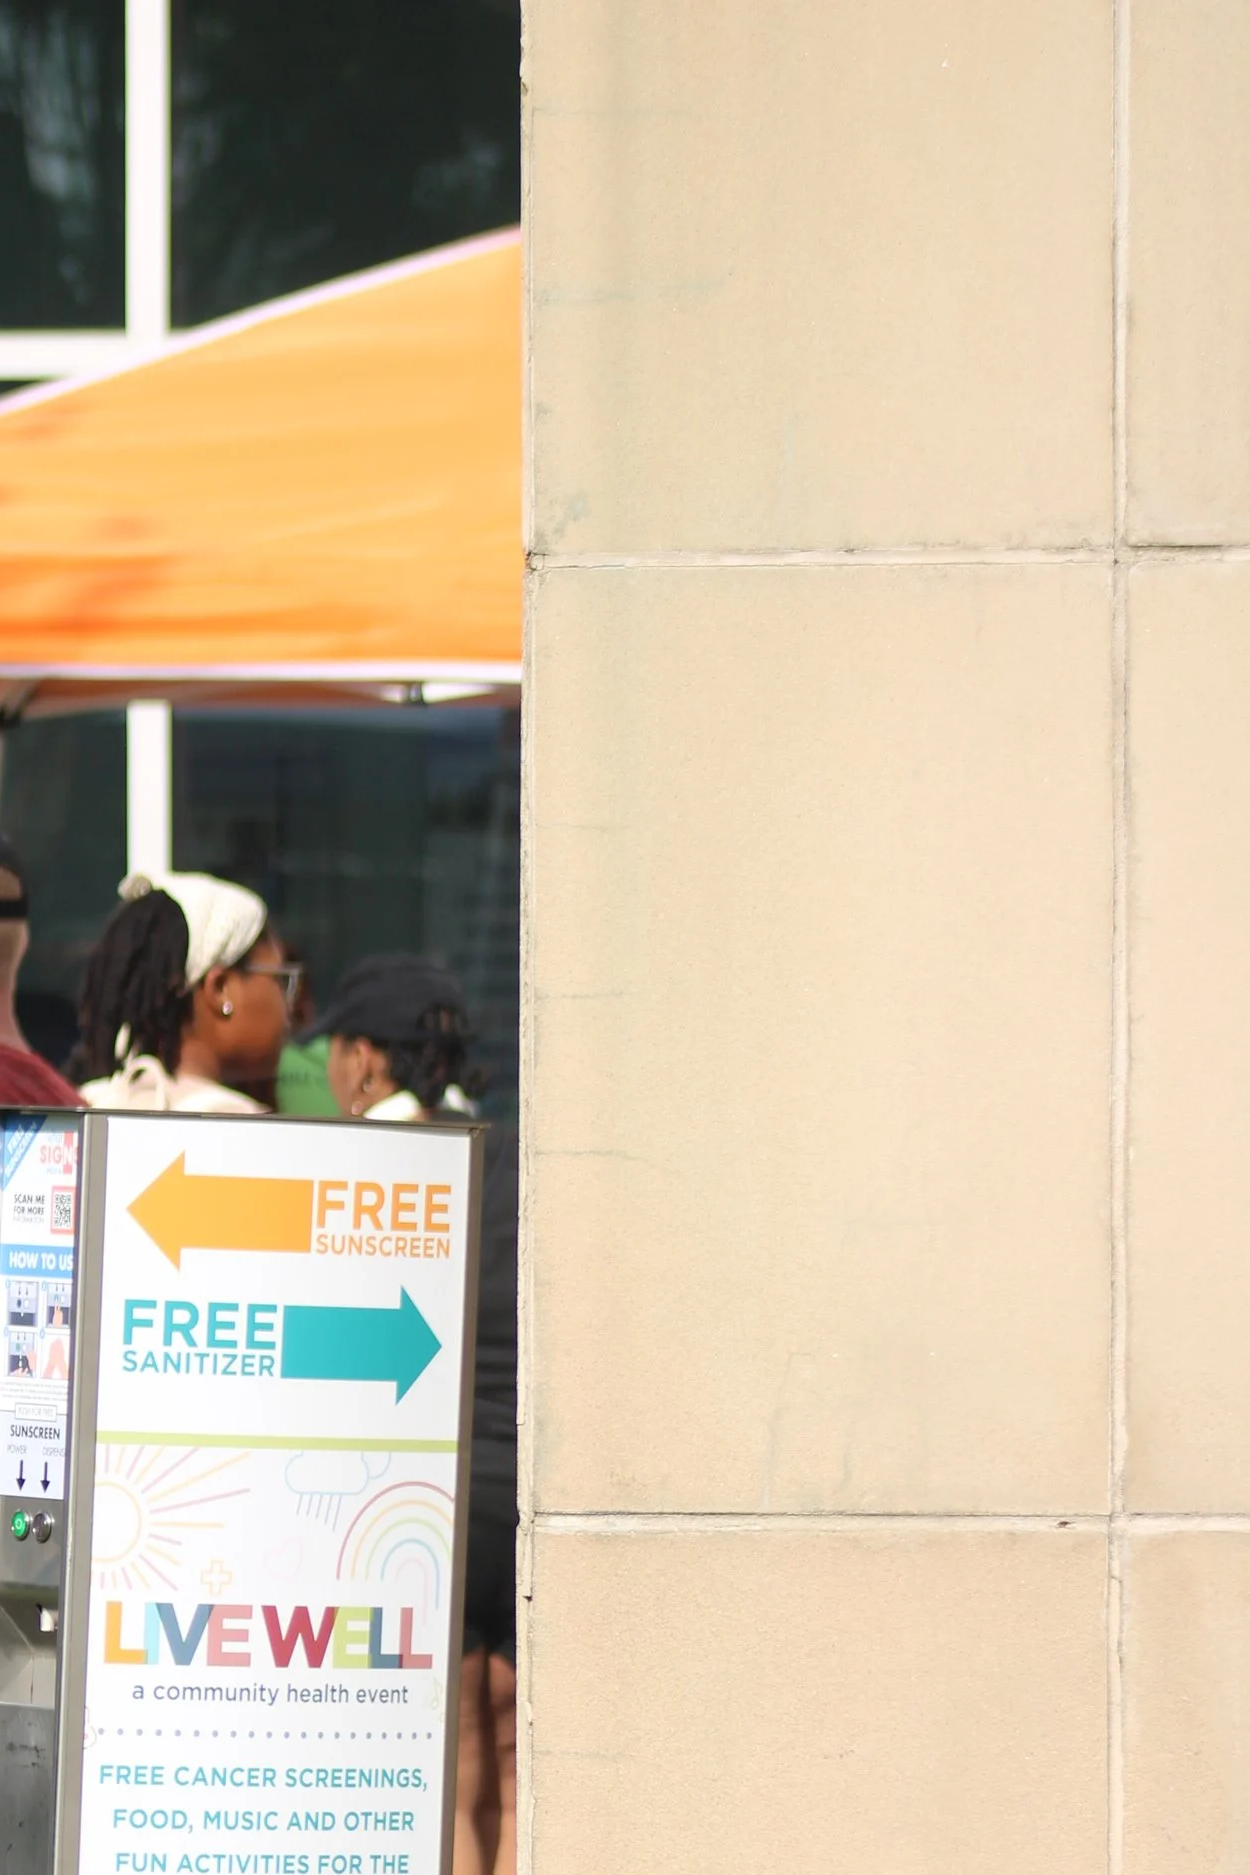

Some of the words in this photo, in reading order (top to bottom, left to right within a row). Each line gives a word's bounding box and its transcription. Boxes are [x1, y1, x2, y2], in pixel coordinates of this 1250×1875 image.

[13, 1193, 33, 1205] SCAN
[34, 1195, 46, 1205] ME
[13, 1206, 26, 1215] FOR
[27, 1207, 45, 1216] MORE
[316, 1180, 452, 1233] FREE
[315, 1233, 451, 1260] SUNSCREEN
[9, 1251, 39, 1270] HOW
[41, 1253, 57, 1270] TO
[122, 1298, 279, 1351] FREE
[122, 1350, 276, 1378] SANITIZER
[10, 1424, 61, 1440] SUNSCREEN
[7, 1444, 28, 1455] POWER
[104, 1601, 253, 1667] LIVE
[261, 1605, 433, 1669] WELL
[132, 1684, 144, 1699] a
[153, 1683, 279, 1706] community
[286, 1683, 350, 1704] health
[356, 1685, 409, 1704] event
[99, 1765, 165, 1786] FREE
[174, 1766, 277, 1788] CANCER
[285, 1768, 428, 1792] SCREENINGS,
[112, 1808, 194, 1834] FOOD,
[203, 1810, 279, 1831] MUSIC
[286, 1811, 337, 1831] AND
[344, 1811, 415, 1831] OTHER
[115, 1853, 167, 1873] FUN
[176, 1854, 310, 1875] ACTIVITIES
[318, 1855, 363, 1874] FOR
[369, 1854, 409, 1874] THE
